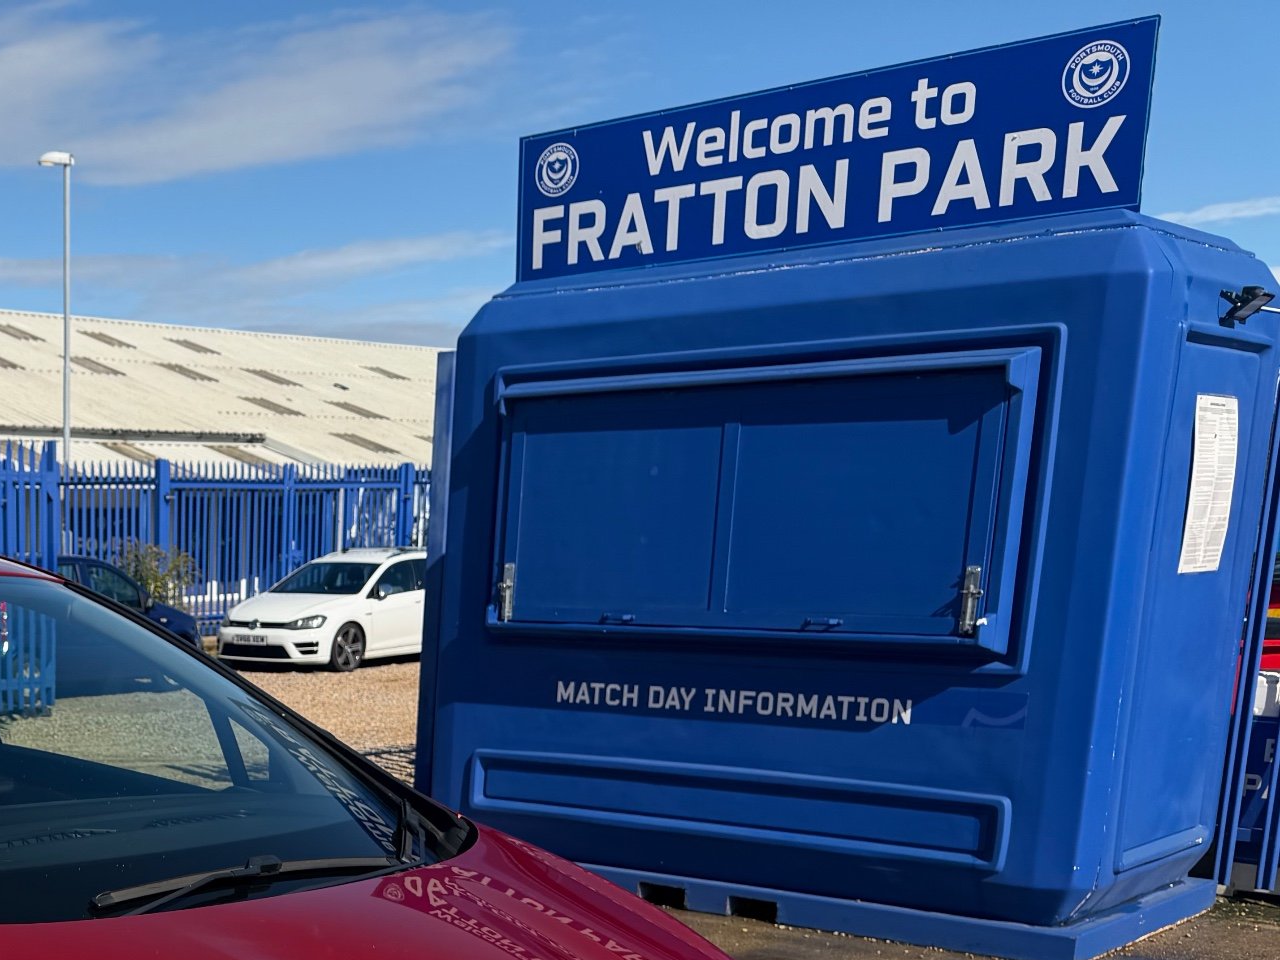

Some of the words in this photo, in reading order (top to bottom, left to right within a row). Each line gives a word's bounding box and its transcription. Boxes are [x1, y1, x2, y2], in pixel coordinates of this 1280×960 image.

[1070, 44, 1125, 69] PORTSMOUTH
[1068, 88, 1103, 104] FOOTBALL
[1103, 80, 1121, 98] CLUB
[642, 95, 892, 176] Welcome
[911, 77, 977, 130] to
[531, 157, 850, 271] FRATTON
[877, 114, 1128, 223] PARK
[556, 680, 639, 708] MATCH
[648, 685, 696, 711] DAY
[704, 689, 912, 725] INFORMATION
